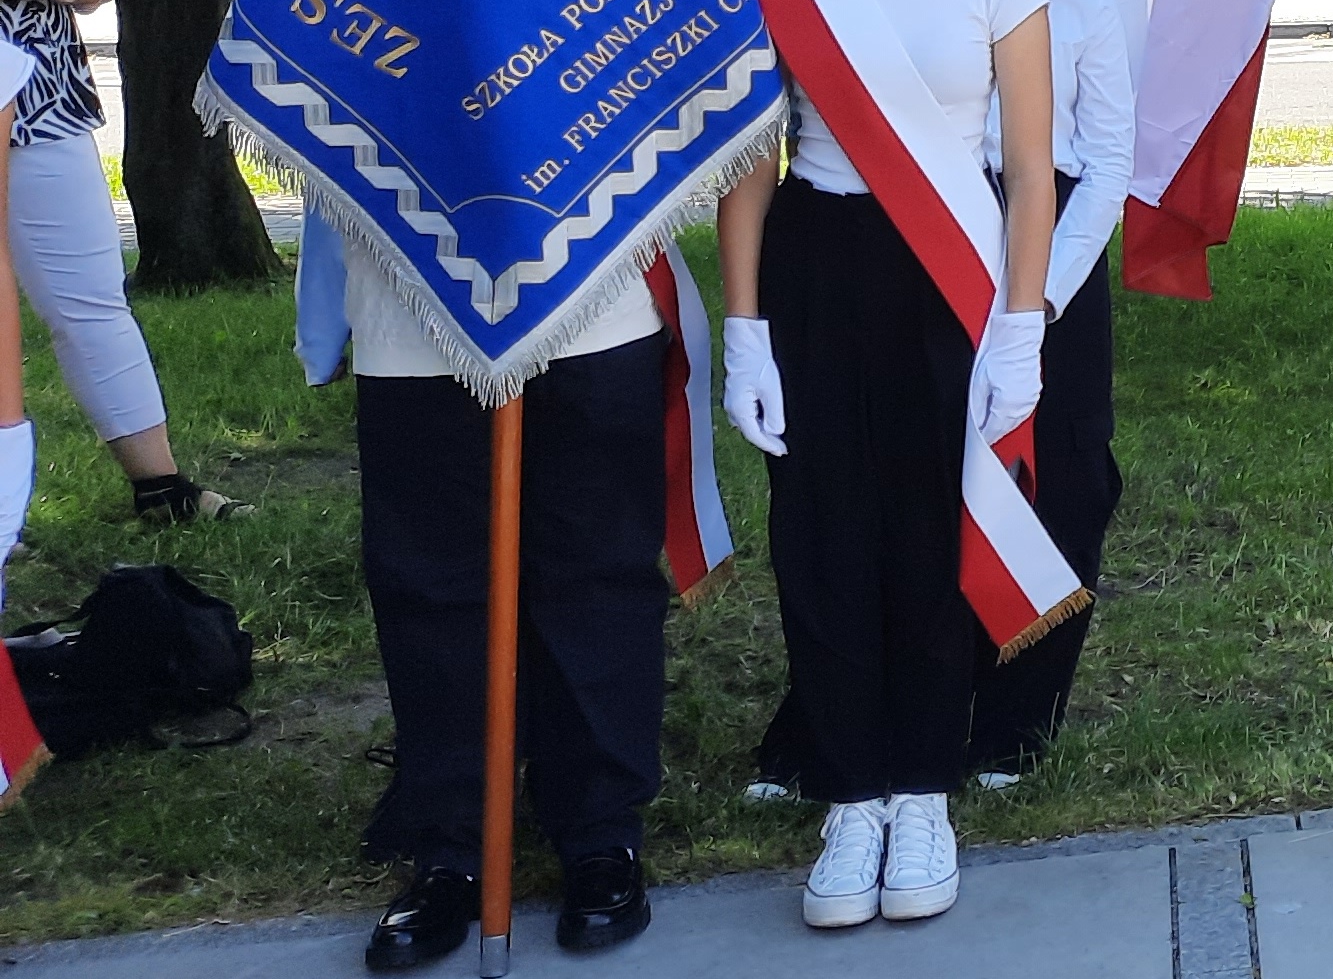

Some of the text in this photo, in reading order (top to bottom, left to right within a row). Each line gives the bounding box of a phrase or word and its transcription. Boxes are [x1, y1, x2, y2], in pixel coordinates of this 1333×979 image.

[461, 27, 566, 120] SZKOŁA
[520, 158, 570, 194] im.
[562, 10, 721, 154] FRANCISZKI
